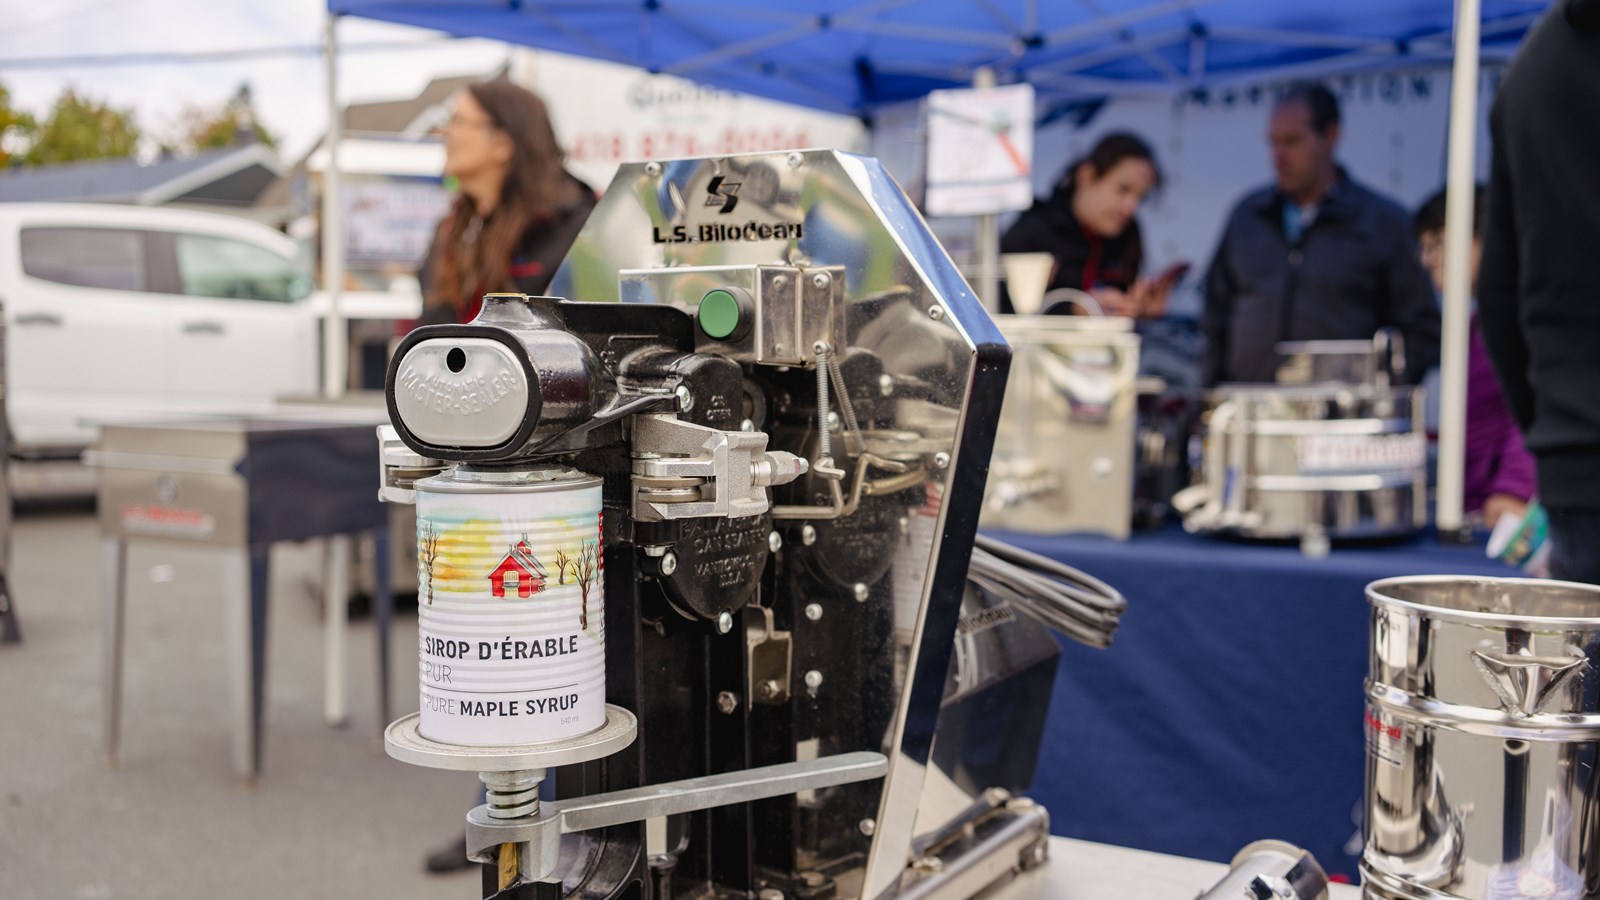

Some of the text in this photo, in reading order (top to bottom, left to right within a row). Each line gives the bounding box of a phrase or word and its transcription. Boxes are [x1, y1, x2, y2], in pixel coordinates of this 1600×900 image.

[699, 221, 803, 243] Bilodeau
[425, 634, 578, 661] SIROP D'ÉRABLE
[426, 661, 452, 684] PUR
[426, 693, 579, 717] PURE MAPLE SYRUP
